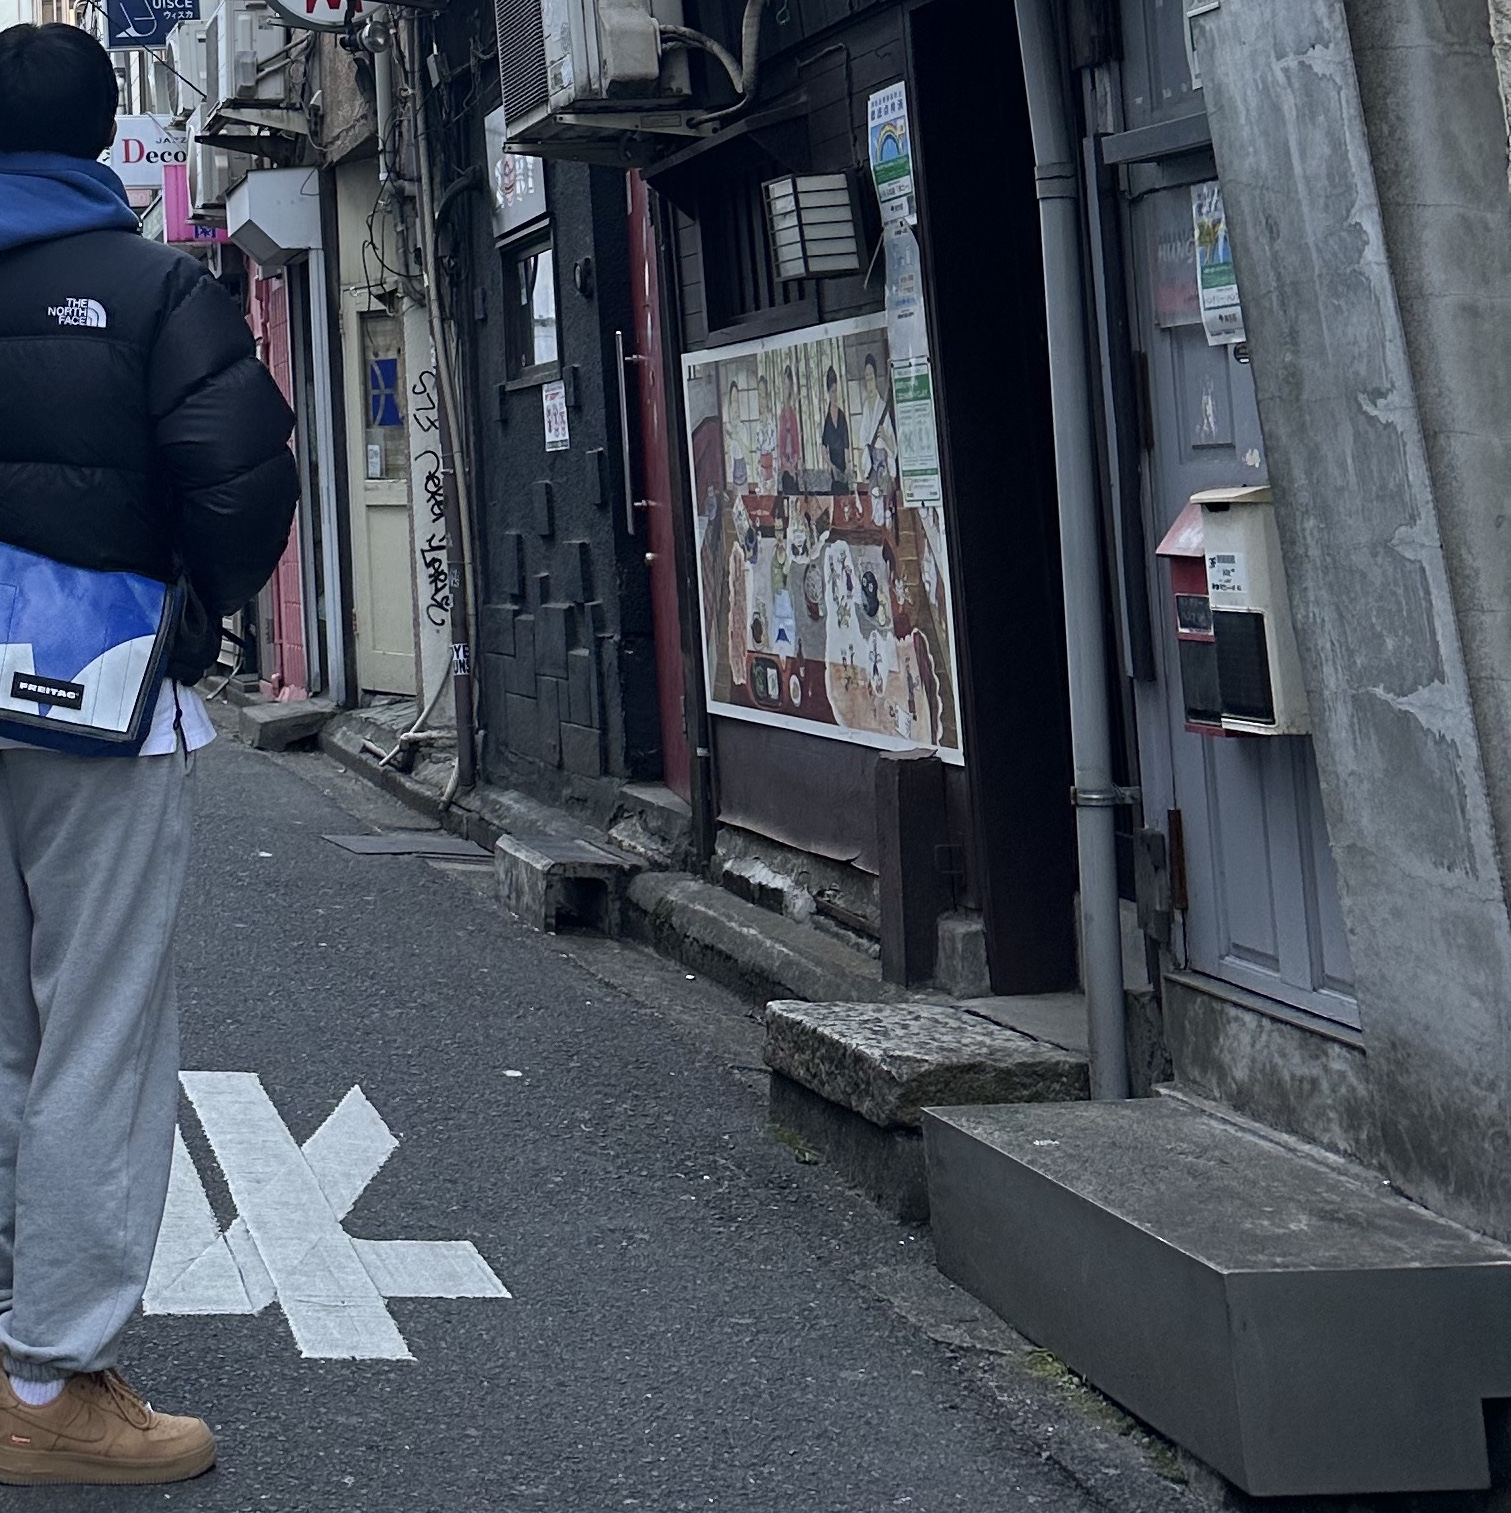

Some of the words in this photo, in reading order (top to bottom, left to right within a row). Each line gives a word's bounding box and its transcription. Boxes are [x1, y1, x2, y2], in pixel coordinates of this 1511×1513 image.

[121, 138, 187, 164] Deco
[66, 298, 88, 308] THE
[48, 306, 87, 317] NORTH
[59, 316, 87, 326] FACE
[19, 681, 76, 700] FREITAG
